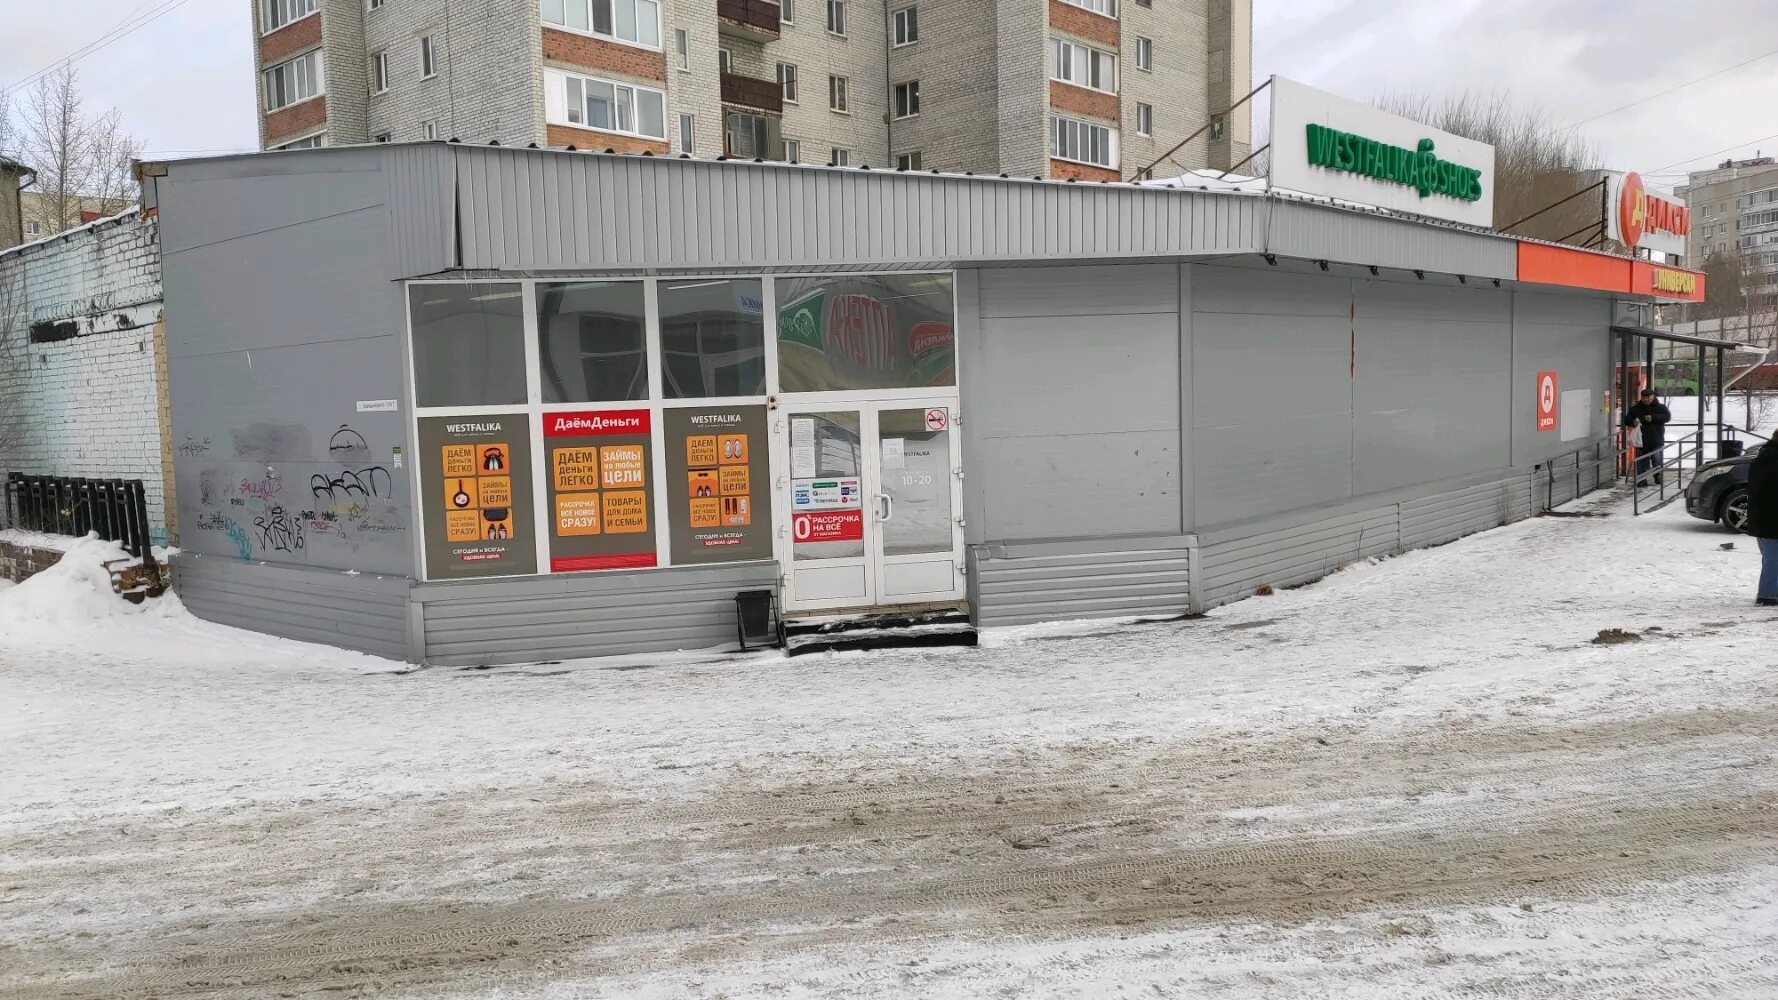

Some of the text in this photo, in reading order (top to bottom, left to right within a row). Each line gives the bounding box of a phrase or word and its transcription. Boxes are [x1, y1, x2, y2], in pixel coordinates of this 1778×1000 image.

[1306, 123, 1482, 201] WESTFALIKA SHOES
[1645, 195, 1690, 236] ДИКСИ
[554, 416, 639, 431] ДаёмДеньги
[691, 414, 742, 424] WESTFALIKA
[446, 422, 502, 433] WESTFALIKA
[447, 448, 472, 458] ДАЁМ
[558, 450, 592, 466] ДАЁМ
[603, 449, 641, 461] ЗАЙМЫ
[691, 454, 714, 462] ЛЕГКО
[447, 465, 472, 473] ЛЕГКО
[559, 466, 593, 475] деньги
[560, 475, 593, 486] ЛЕГКО
[607, 497, 642, 506] ТОВАРЫ
[622, 508, 642, 516] ДОМА
[561, 517, 596, 528] СРАЗУ!
[607, 517, 643, 527] И СЕМЬИ
[812, 515, 860, 524] РАССРОЧКА
